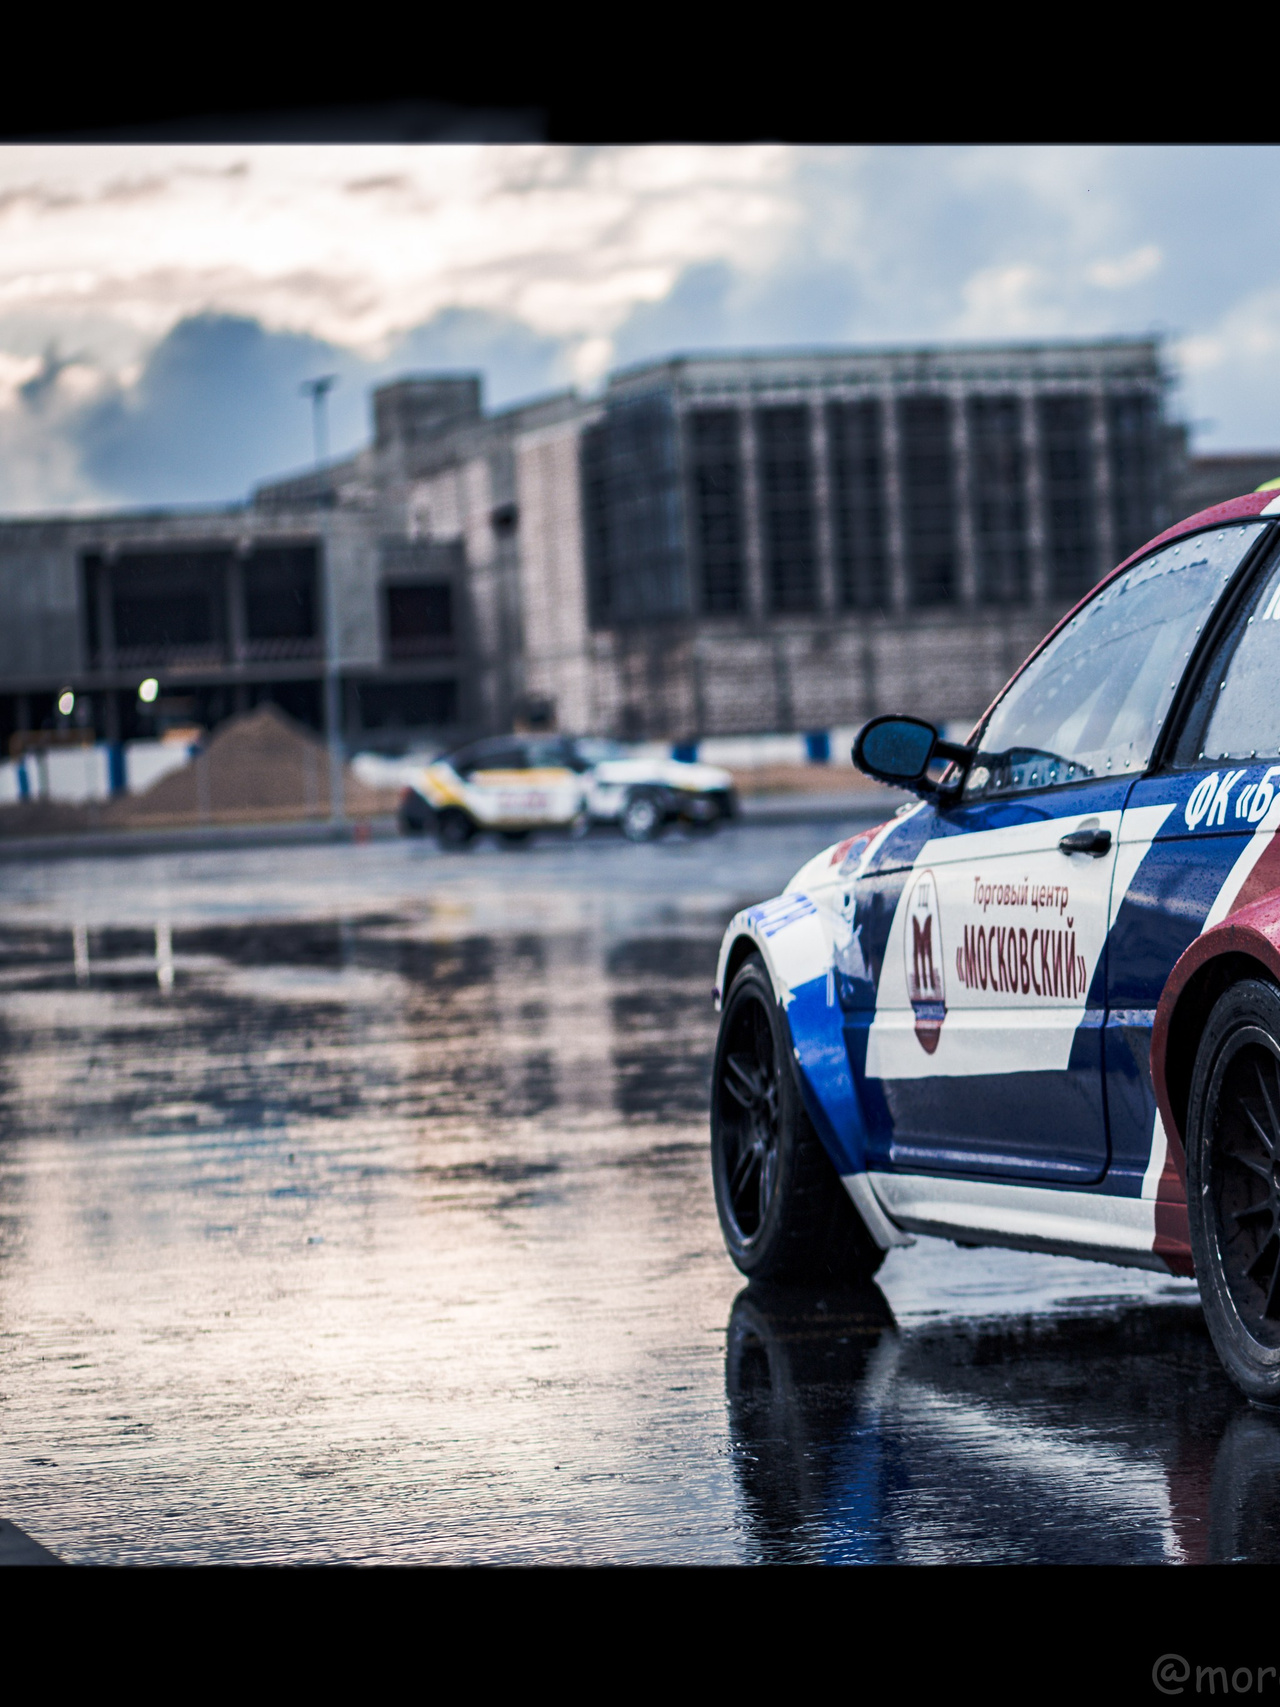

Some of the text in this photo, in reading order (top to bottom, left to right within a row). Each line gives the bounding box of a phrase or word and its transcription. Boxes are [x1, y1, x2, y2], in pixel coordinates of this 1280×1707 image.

[1184, 768, 1248, 831] ФК
[973, 876, 1069, 916] Торговый центр
[956, 916, 1087, 1000] «МОСКОВСКИЙ»
